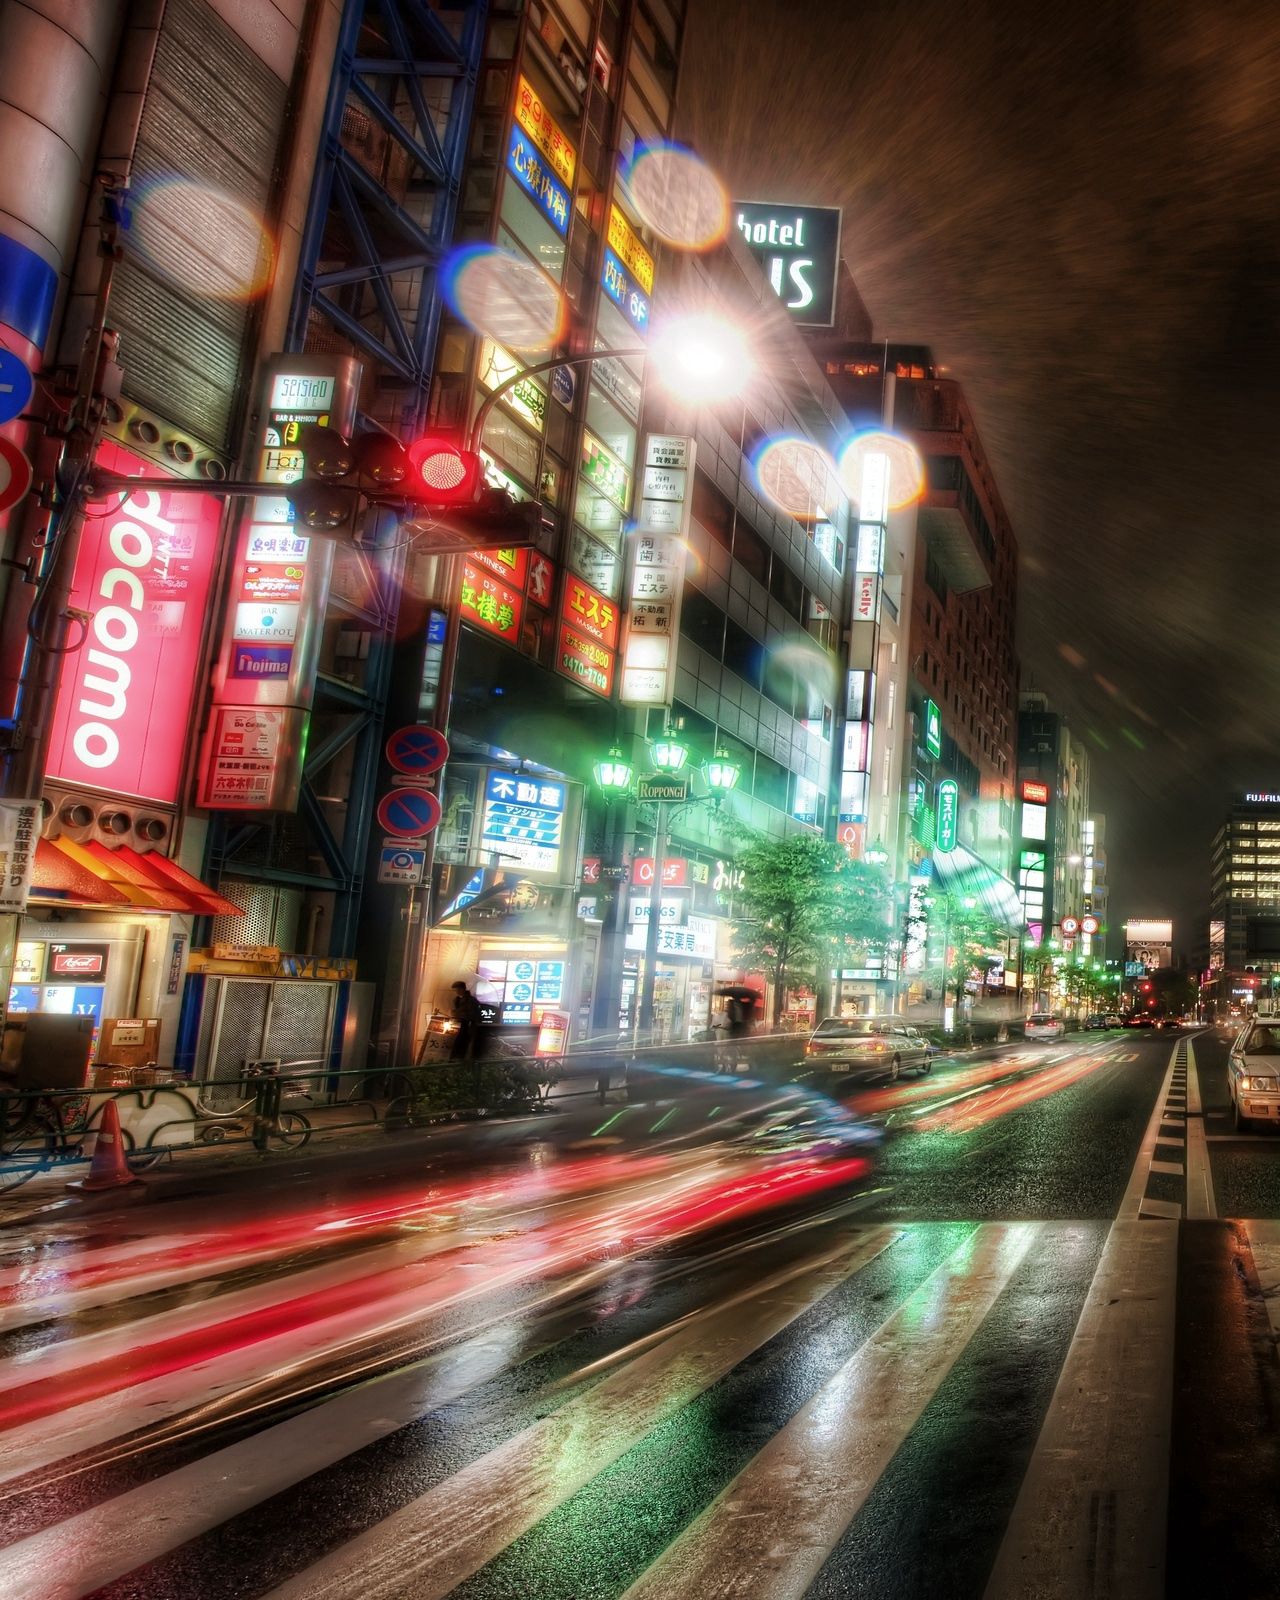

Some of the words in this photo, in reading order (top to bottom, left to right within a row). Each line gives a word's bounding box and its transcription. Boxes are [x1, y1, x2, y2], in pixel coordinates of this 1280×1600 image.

[511, 141, 568, 227] 心療内科
[737, 213, 805, 247] hotel
[605, 259, 627, 304] 内科
[629, 291, 647, 323] 6F
[153, 537, 174, 580] NTT
[483, 580, 497, 592] ロン
[638, 583, 669, 594] エステ
[858, 577, 873, 616] Kelly
[570, 584, 614, 630] エステ
[637, 604, 666, 614] 不動産
[72, 474, 176, 770] docomo
[239, 627, 272, 637] WATER
[272, 628, 293, 637] POT
[575, 617, 604, 640] MASSAGE
[492, 777, 562, 808] 不動産
[639, 782, 684, 799] ROPPONGI
[504, 805, 546, 819] マンション
[940, 794, 953, 847] モスバーガー
[634, 905, 677, 918] DRGS
[240, 950, 278, 962] マイヤース
